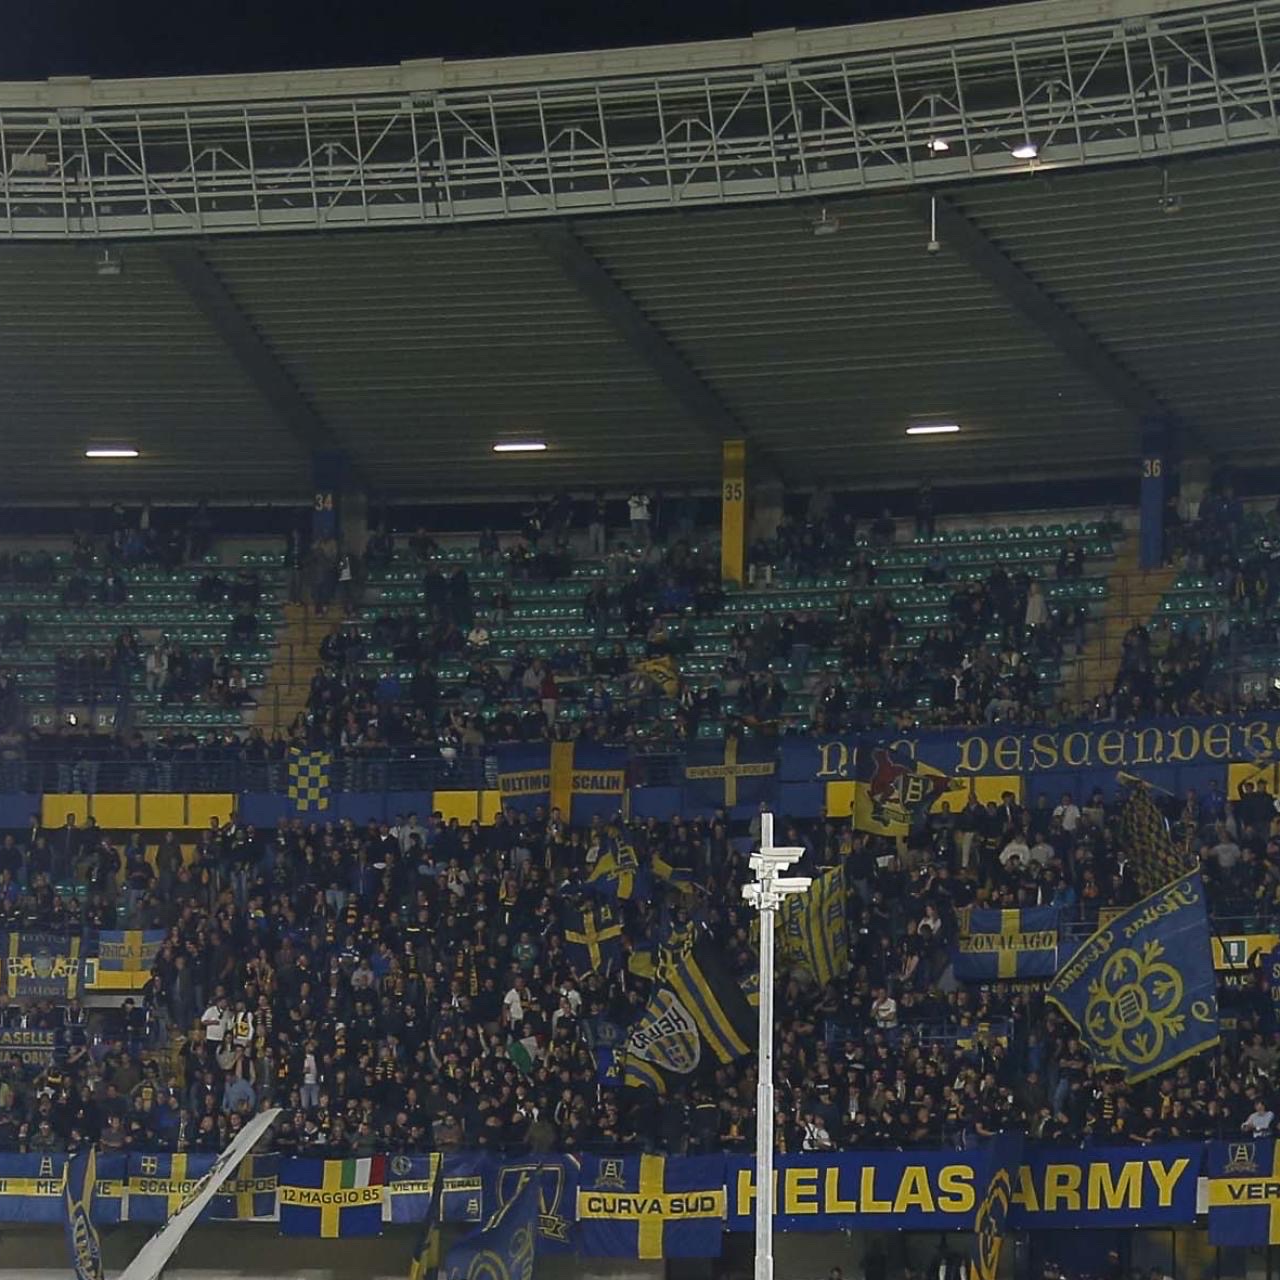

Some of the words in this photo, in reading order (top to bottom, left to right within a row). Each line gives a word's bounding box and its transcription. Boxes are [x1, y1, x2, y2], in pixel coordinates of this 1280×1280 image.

[1143, 459, 1161, 477] 36
[724, 483, 742, 501] 35
[315, 493, 332, 511] 34
[736, 1164, 977, 1217] HELLAS
[1010, 1156, 1191, 1213] ARMY
[281, 1189, 296, 1202] 12
[299, 1189, 359, 1205] MAGGIO
[362, 1188, 381, 1201] 85
[587, 1196, 663, 1215] CURVA
[669, 1196, 717, 1214] SUD
